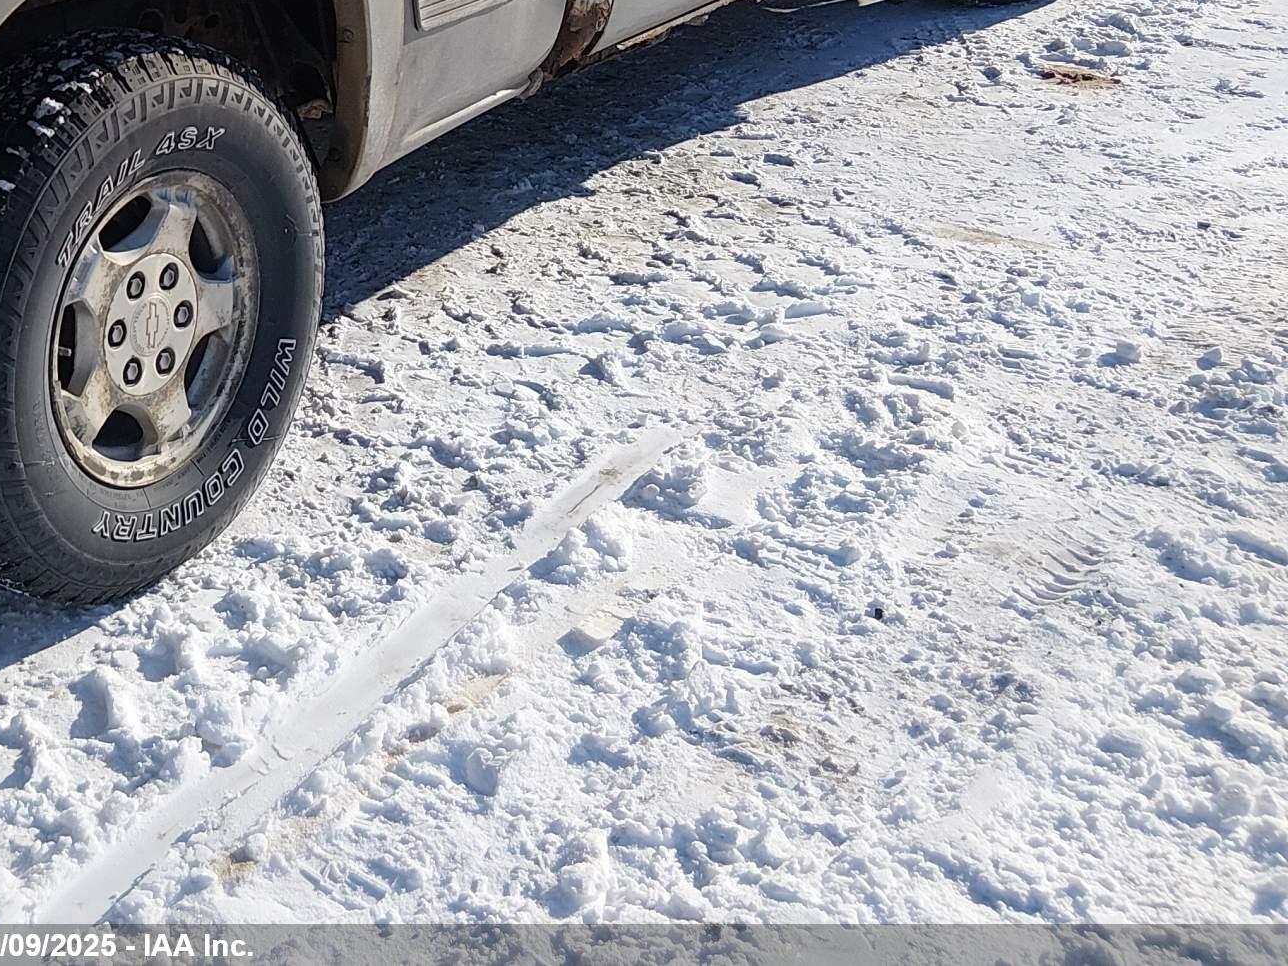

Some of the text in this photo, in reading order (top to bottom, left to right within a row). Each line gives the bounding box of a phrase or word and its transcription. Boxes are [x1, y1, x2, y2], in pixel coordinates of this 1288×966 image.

[56, 125, 226, 267] TRAIL 4SX
[247, 338, 297, 446] WILD
[92, 448, 245, 541] COUNTRY
